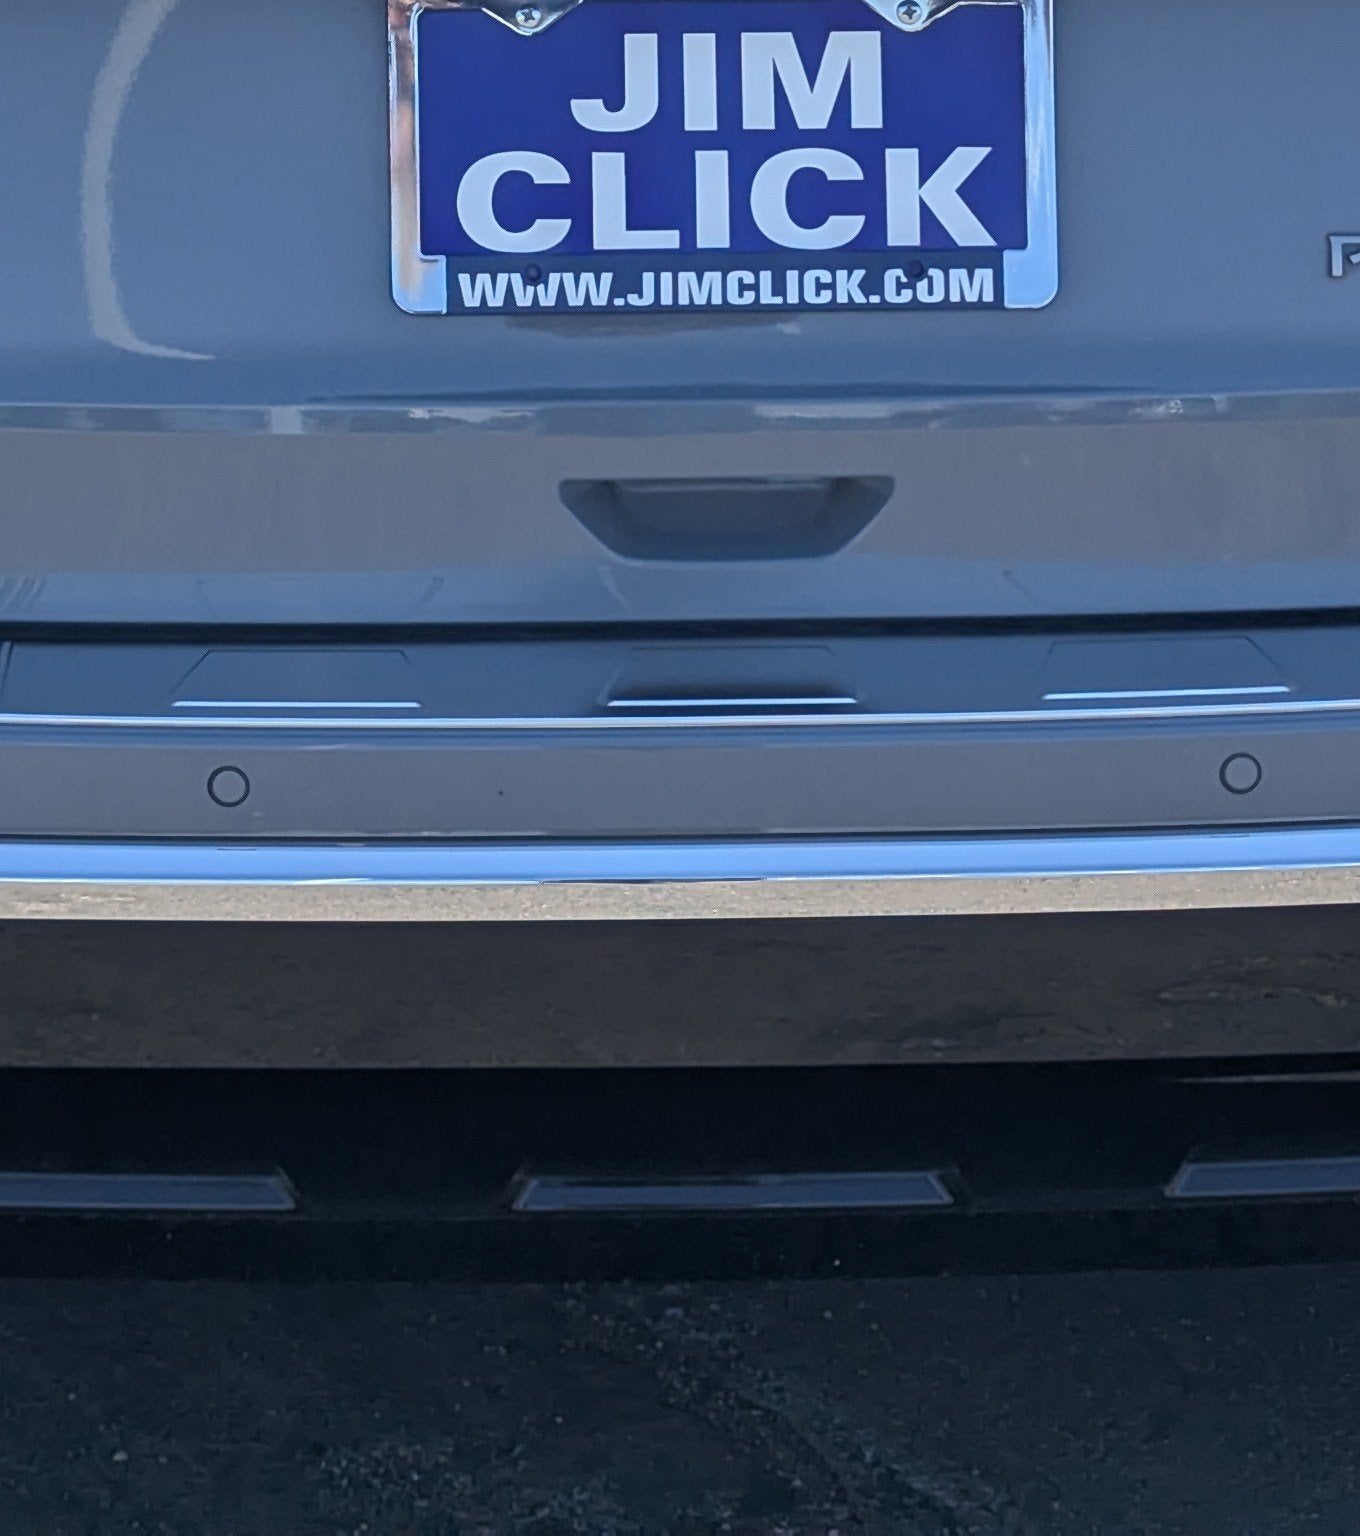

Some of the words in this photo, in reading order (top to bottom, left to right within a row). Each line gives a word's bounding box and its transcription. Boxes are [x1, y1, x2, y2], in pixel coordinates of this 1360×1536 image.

[570, 31, 883, 132] JIM
[456, 147, 997, 253] CLICK
[457, 268, 995, 308] WWW.JIMCLICK.COM
